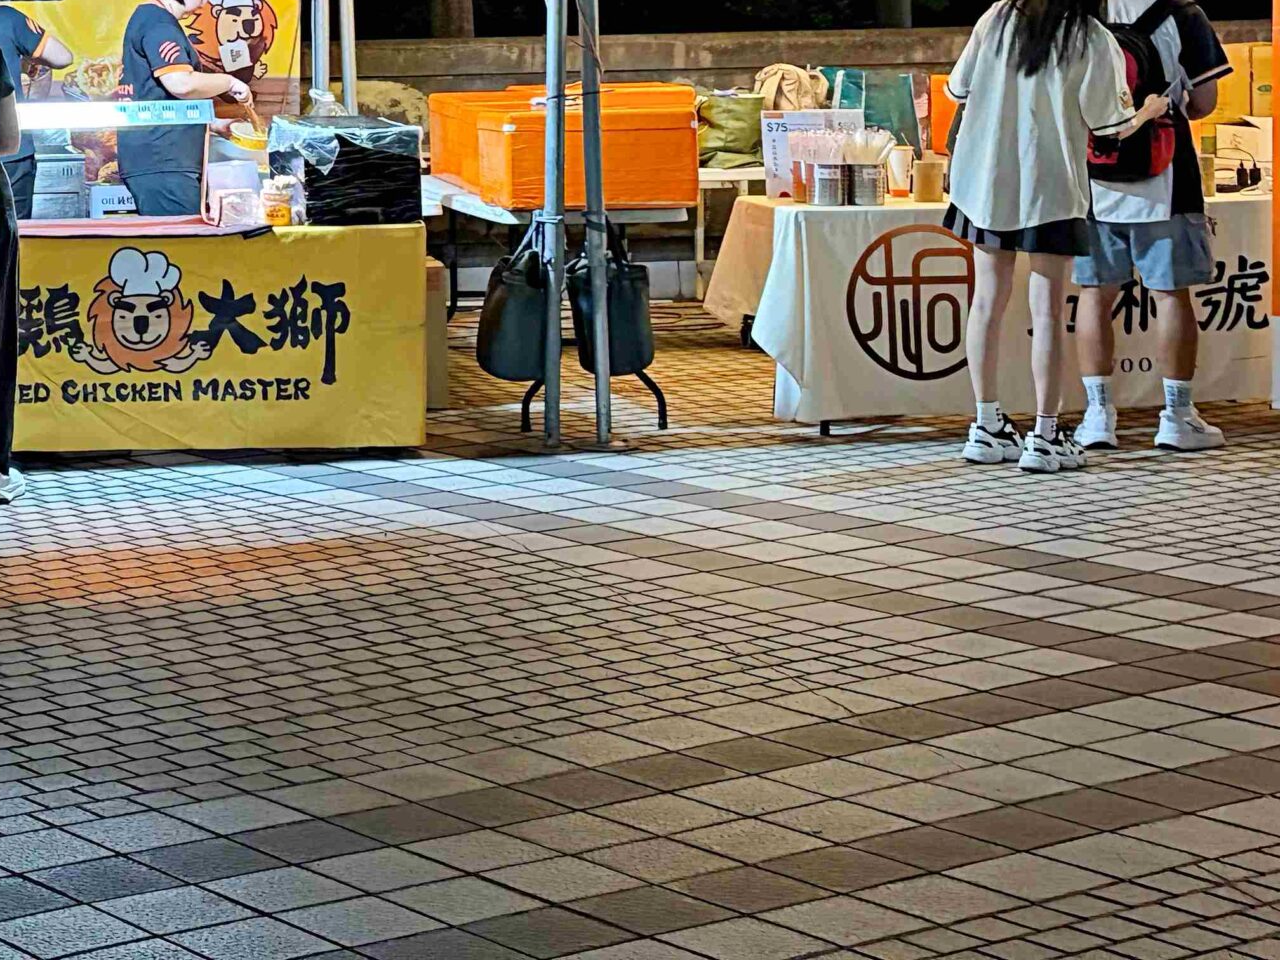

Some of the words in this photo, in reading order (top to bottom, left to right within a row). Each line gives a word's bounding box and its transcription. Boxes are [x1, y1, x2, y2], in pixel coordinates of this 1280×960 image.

[766, 122, 788, 132] $75
[61, 379, 183, 404] CHICKEN
[192, 377, 312, 402] MASTER
